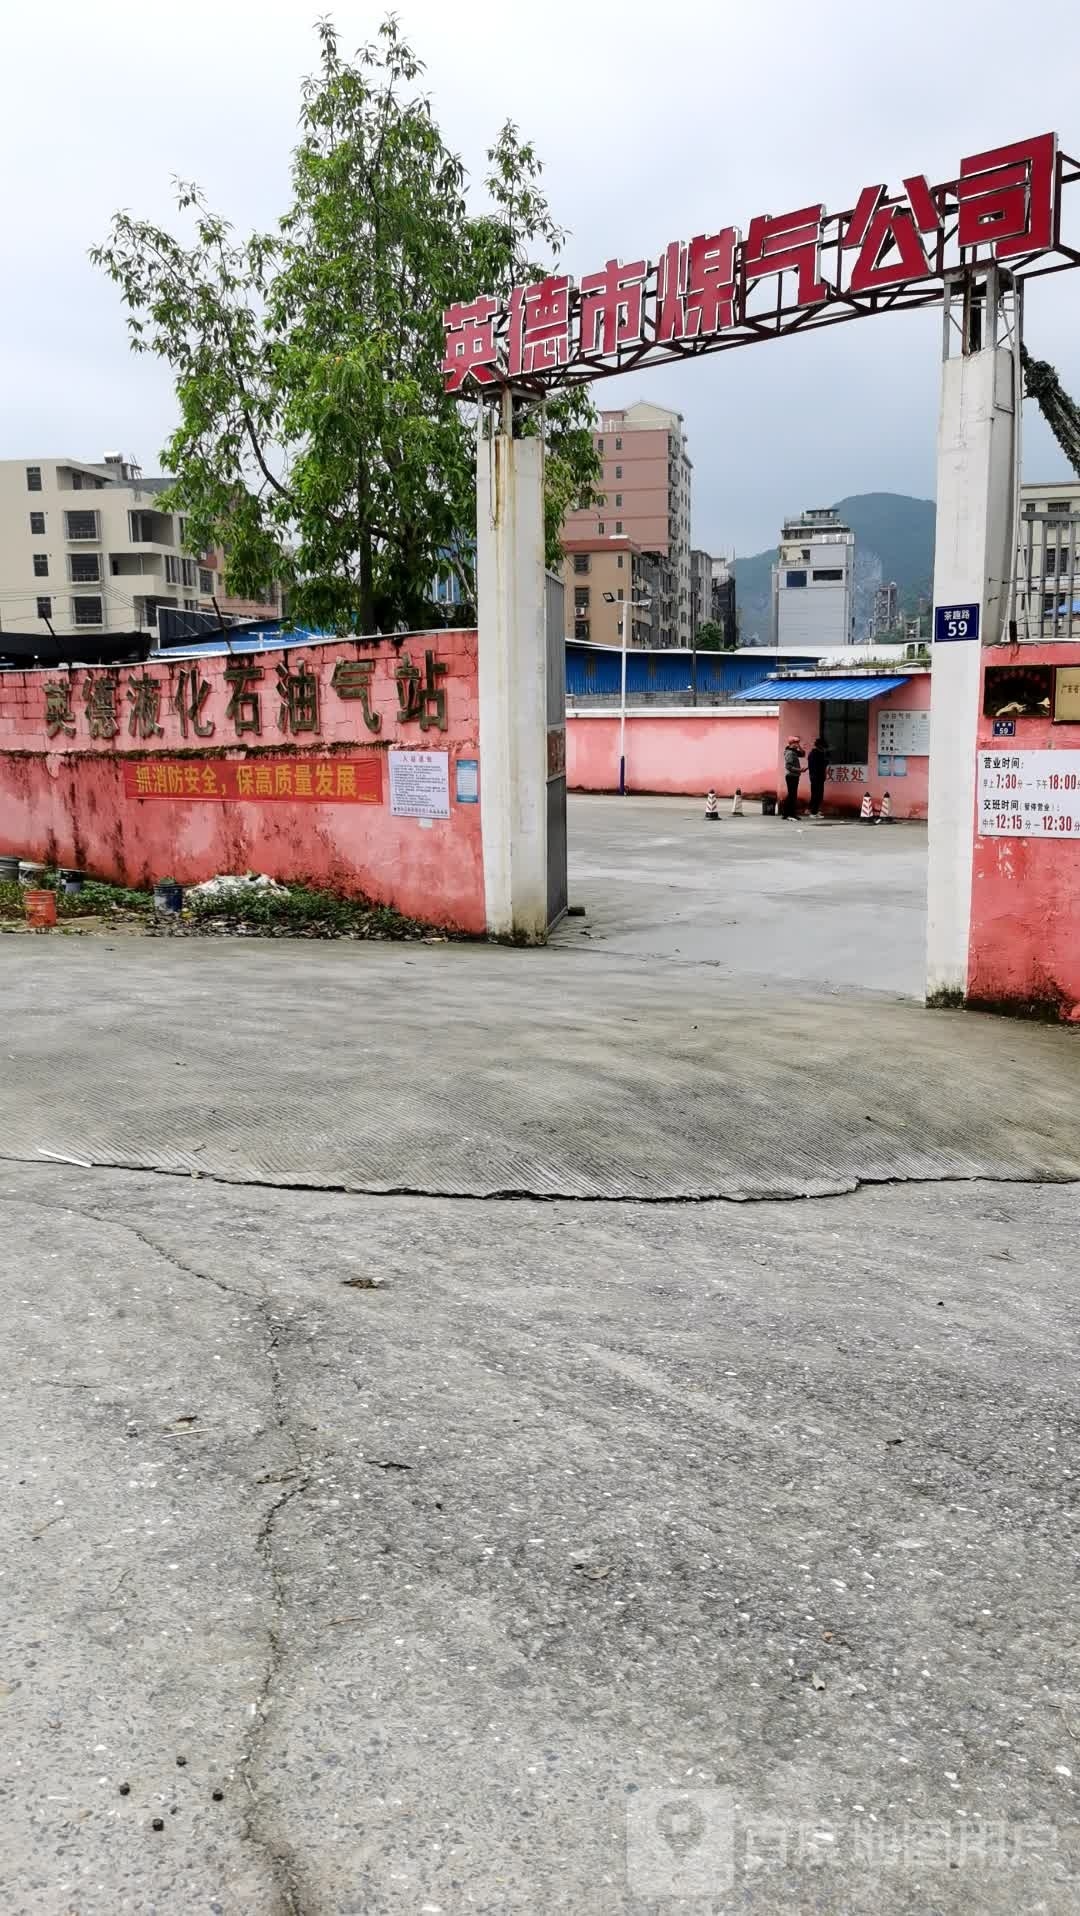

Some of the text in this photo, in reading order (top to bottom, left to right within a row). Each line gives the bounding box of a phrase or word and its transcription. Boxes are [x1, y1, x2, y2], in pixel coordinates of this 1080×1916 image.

[441, 132, 1059, 393] 英德市煤气公司
[947, 620, 968, 637] 59
[42, 649, 448, 739] 英德液化石油气站
